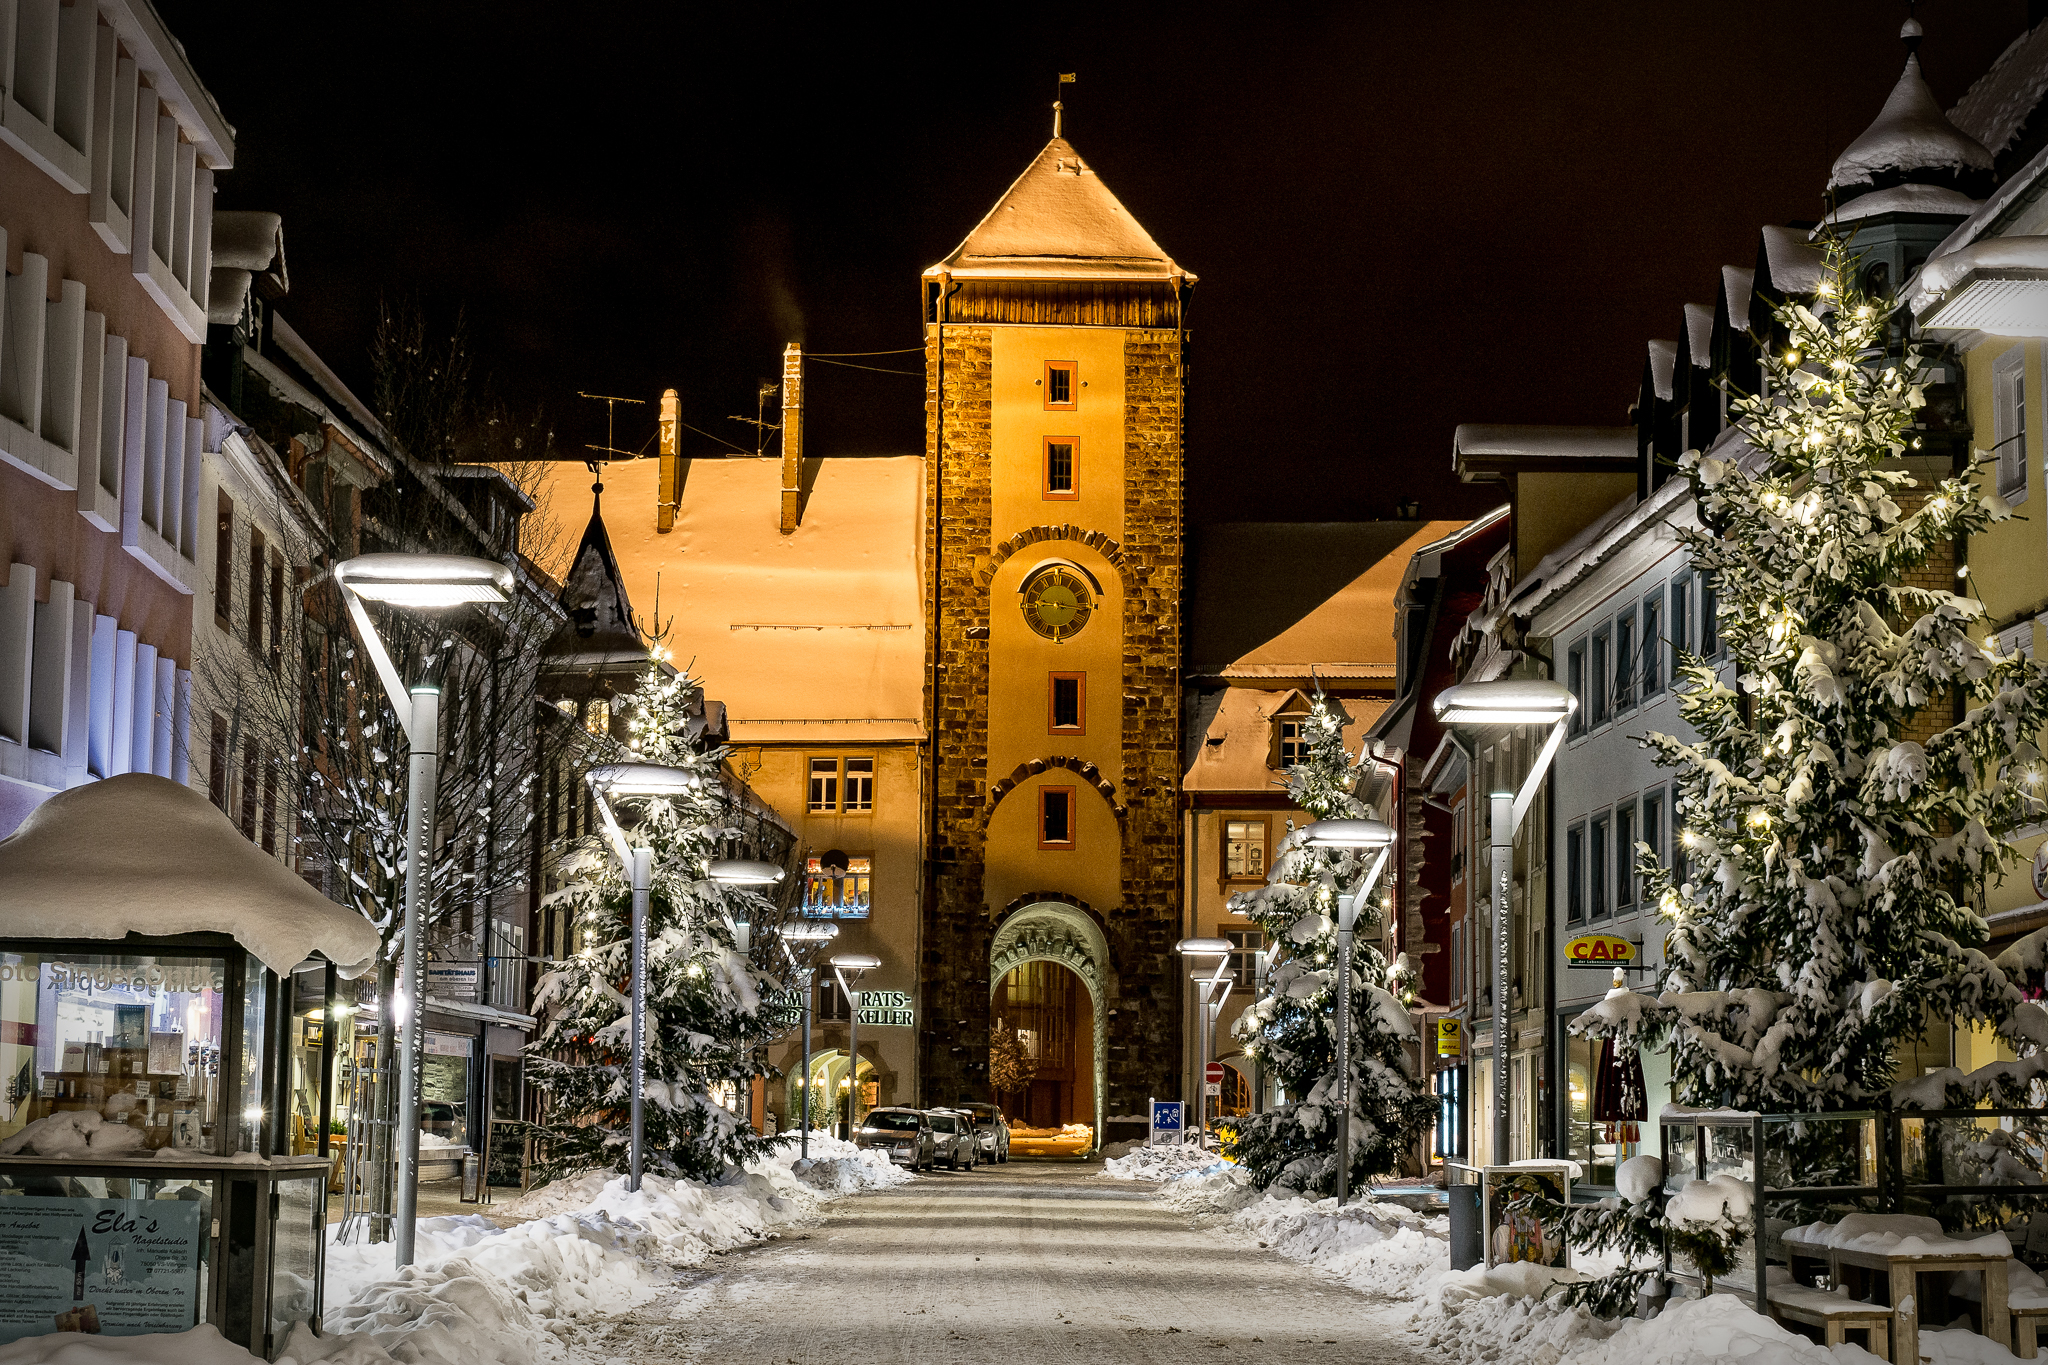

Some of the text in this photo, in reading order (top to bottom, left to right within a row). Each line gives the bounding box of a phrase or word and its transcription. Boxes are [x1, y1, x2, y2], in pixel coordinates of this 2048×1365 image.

[1573, 940, 1627, 960] CAP
[50, 961, 136, 990] Singer
[428, 968, 476, 976] SANITÄTSHAUS
[857, 1009, 913, 1025] KELLER
[491, 1123, 520, 1135] LIVE
[8, 1221, 40, 1230] Angebot
[132, 1234, 188, 1247] Nagelstudio
[88, 1285, 113, 1294] Direkt
[145, 1286, 169, 1295] Oberen
[172, 1287, 185, 1296] Tor
